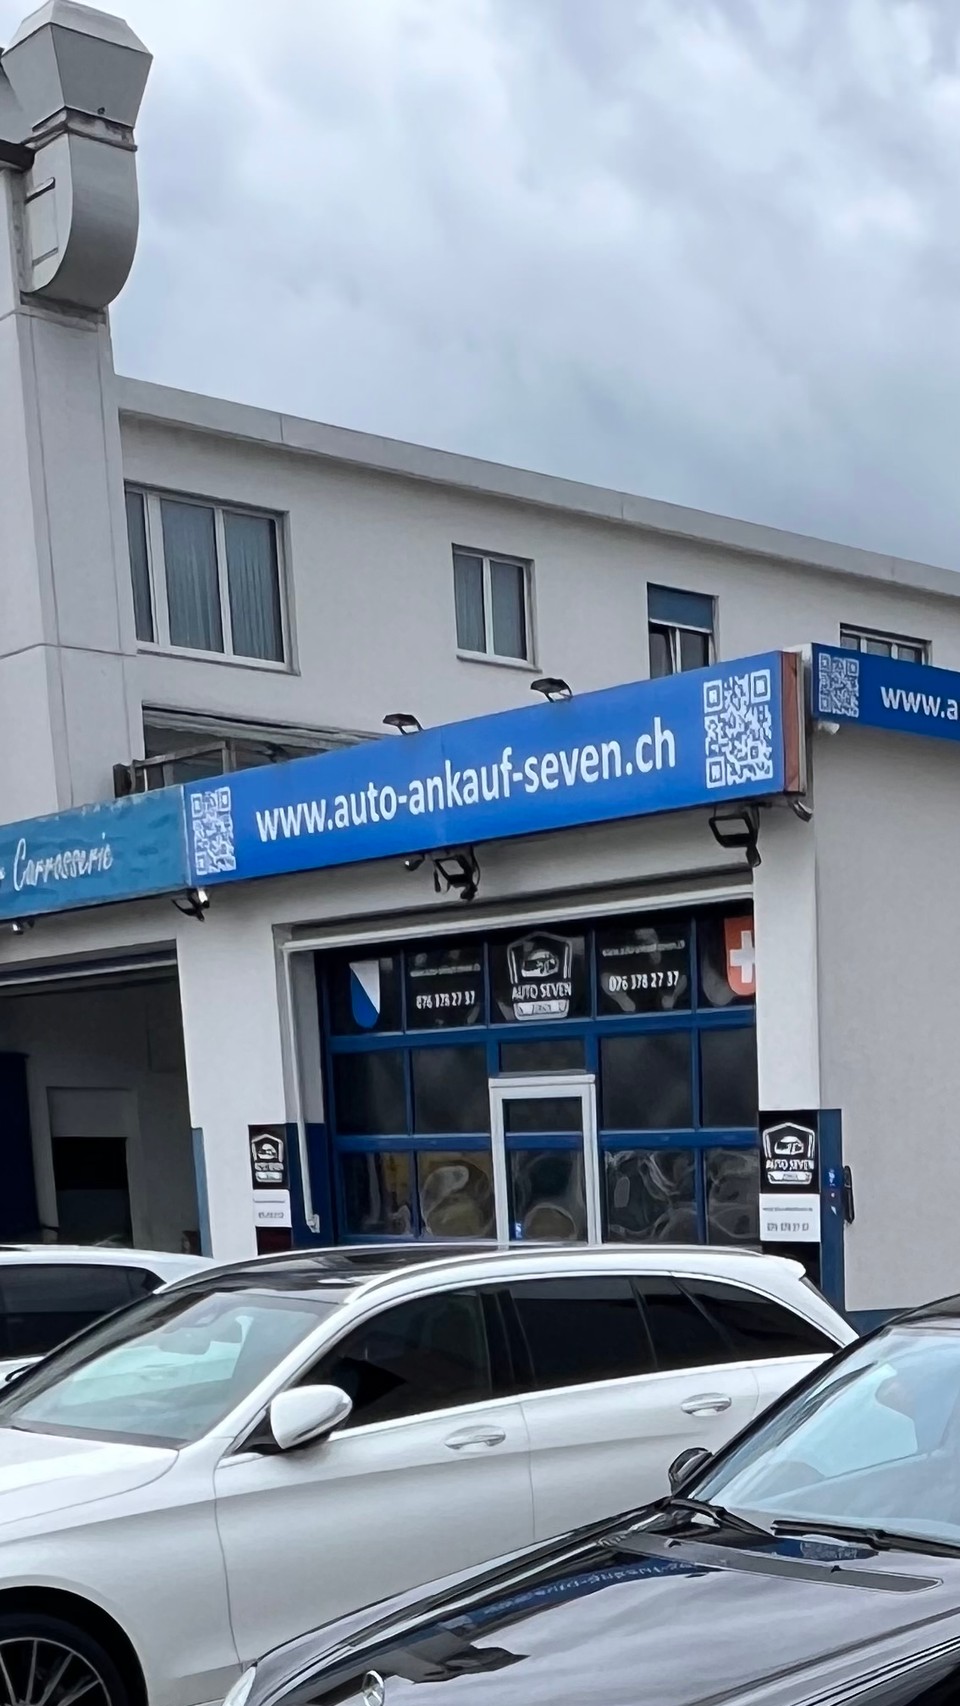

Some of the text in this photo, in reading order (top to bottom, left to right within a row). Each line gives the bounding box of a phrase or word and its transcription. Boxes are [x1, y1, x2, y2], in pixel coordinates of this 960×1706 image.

[255, 716, 677, 843] www.auto-ankauf-seven.ch
[512, 982, 572, 1000] AUTO SEVEN
[608, 975, 629, 992] 076
[650, 971, 664, 988] 27
[451, 991, 462, 1006] 27
